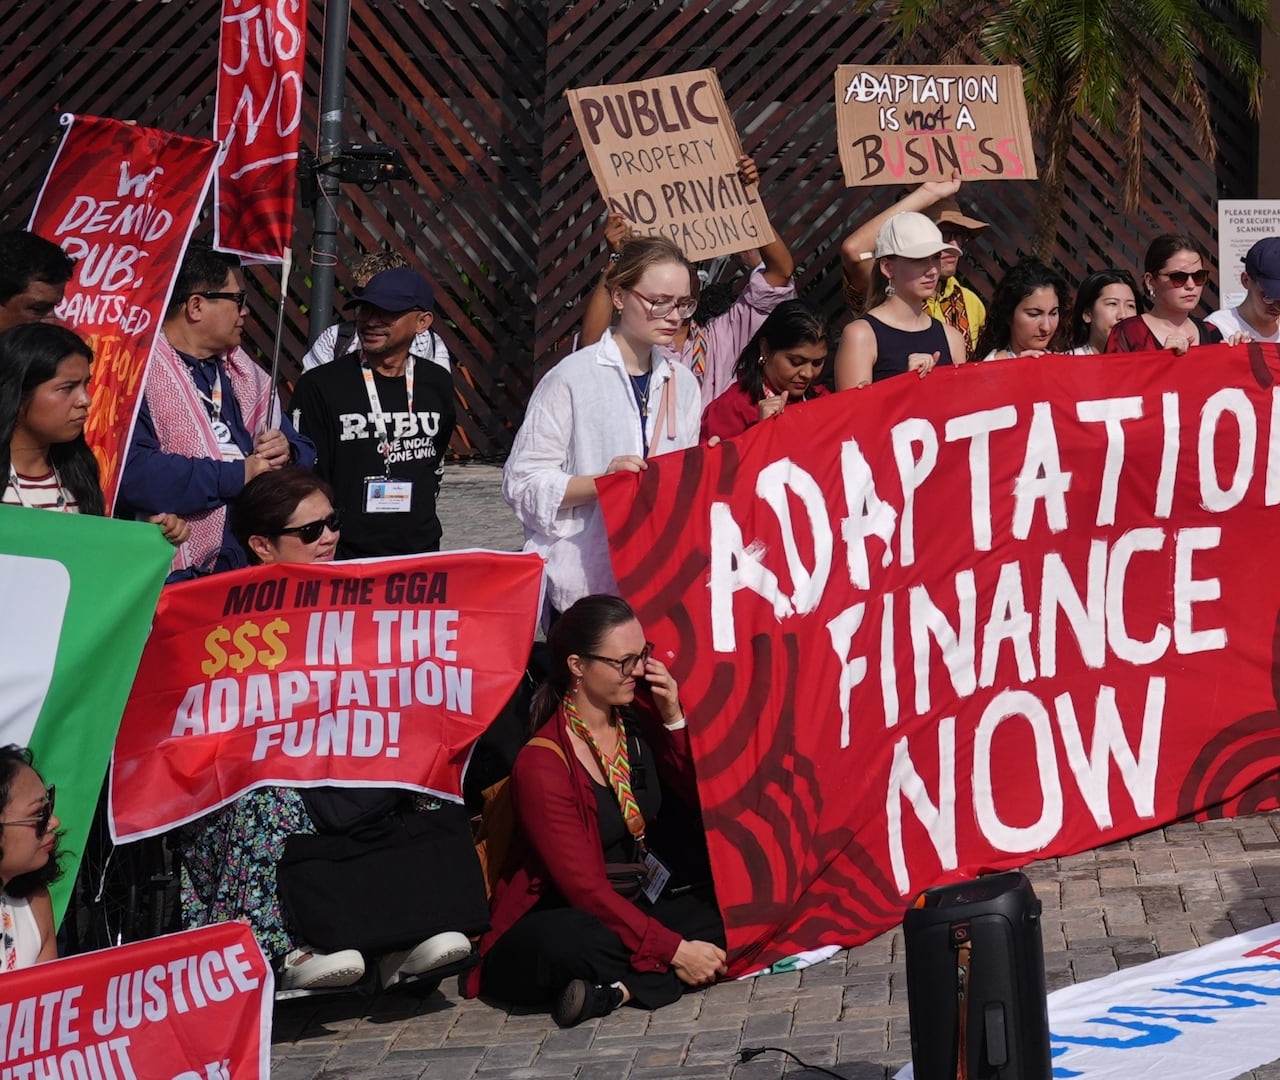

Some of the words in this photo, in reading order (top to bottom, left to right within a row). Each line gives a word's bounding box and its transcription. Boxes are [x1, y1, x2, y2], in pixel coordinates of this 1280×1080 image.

[843, 72, 999, 104] ADAPTATION
[580, 80, 719, 145] PUBLIC
[879, 106, 900, 131] IS
[956, 104, 976, 131] A
[609, 138, 716, 177] PROPERTY
[852, 134, 1025, 181] BUSINESS
[608, 189, 657, 224] NO
[339, 411, 441, 441] RTBU
[388, 451, 413, 463] ONE
[222, 577, 288, 617] MOI
[294, 580, 321, 608] IN
[330, 577, 376, 605] THE
[384, 572, 448, 605] GGA
[201, 617, 290, 678] $$$
[305, 611, 355, 665] IN
[372, 609, 460, 664] THE
[826, 526, 1227, 749] FINANCE
[170, 660, 473, 737] ADAPTATION
[252, 708, 401, 762] FUND!
[889, 677, 1166, 895] NOW
[93, 943, 260, 1036] JUSTICE
